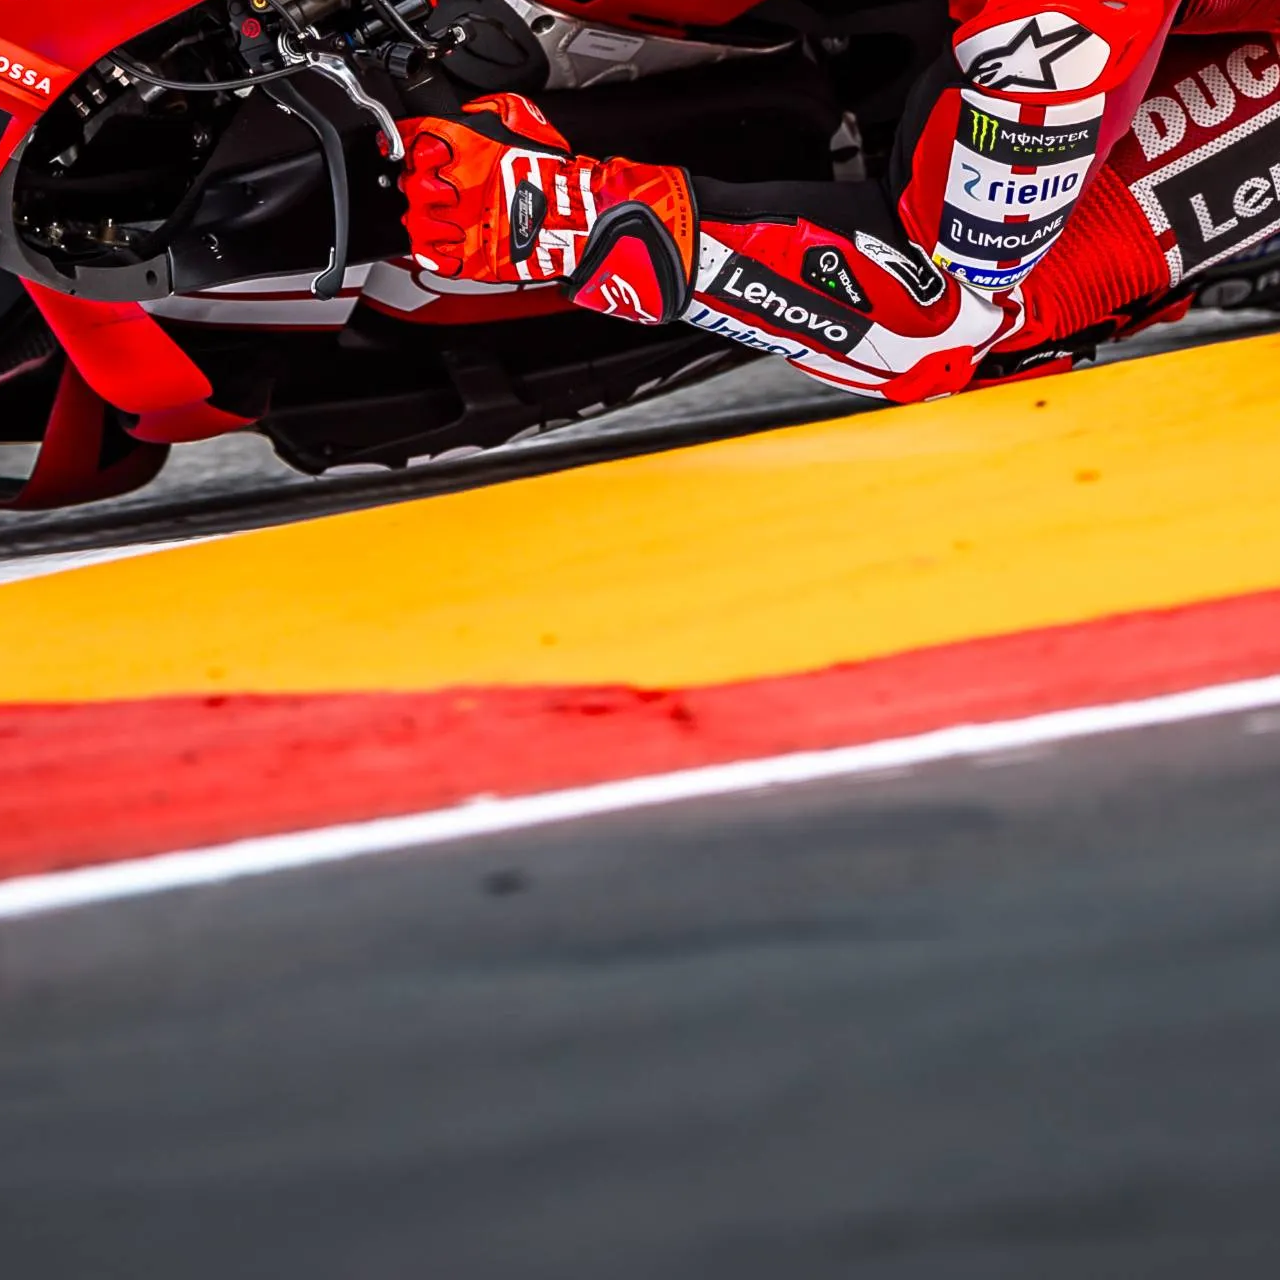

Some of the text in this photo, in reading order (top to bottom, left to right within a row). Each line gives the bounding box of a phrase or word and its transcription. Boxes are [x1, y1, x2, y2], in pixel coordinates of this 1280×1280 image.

[1000, 128, 1090, 147] MONSTER
[1013, 143, 1077, 154] ENERGY
[986, 172, 1080, 206] riello
[967, 214, 1064, 249] LIMOLANE
[723, 266, 849, 343] Lenovo
